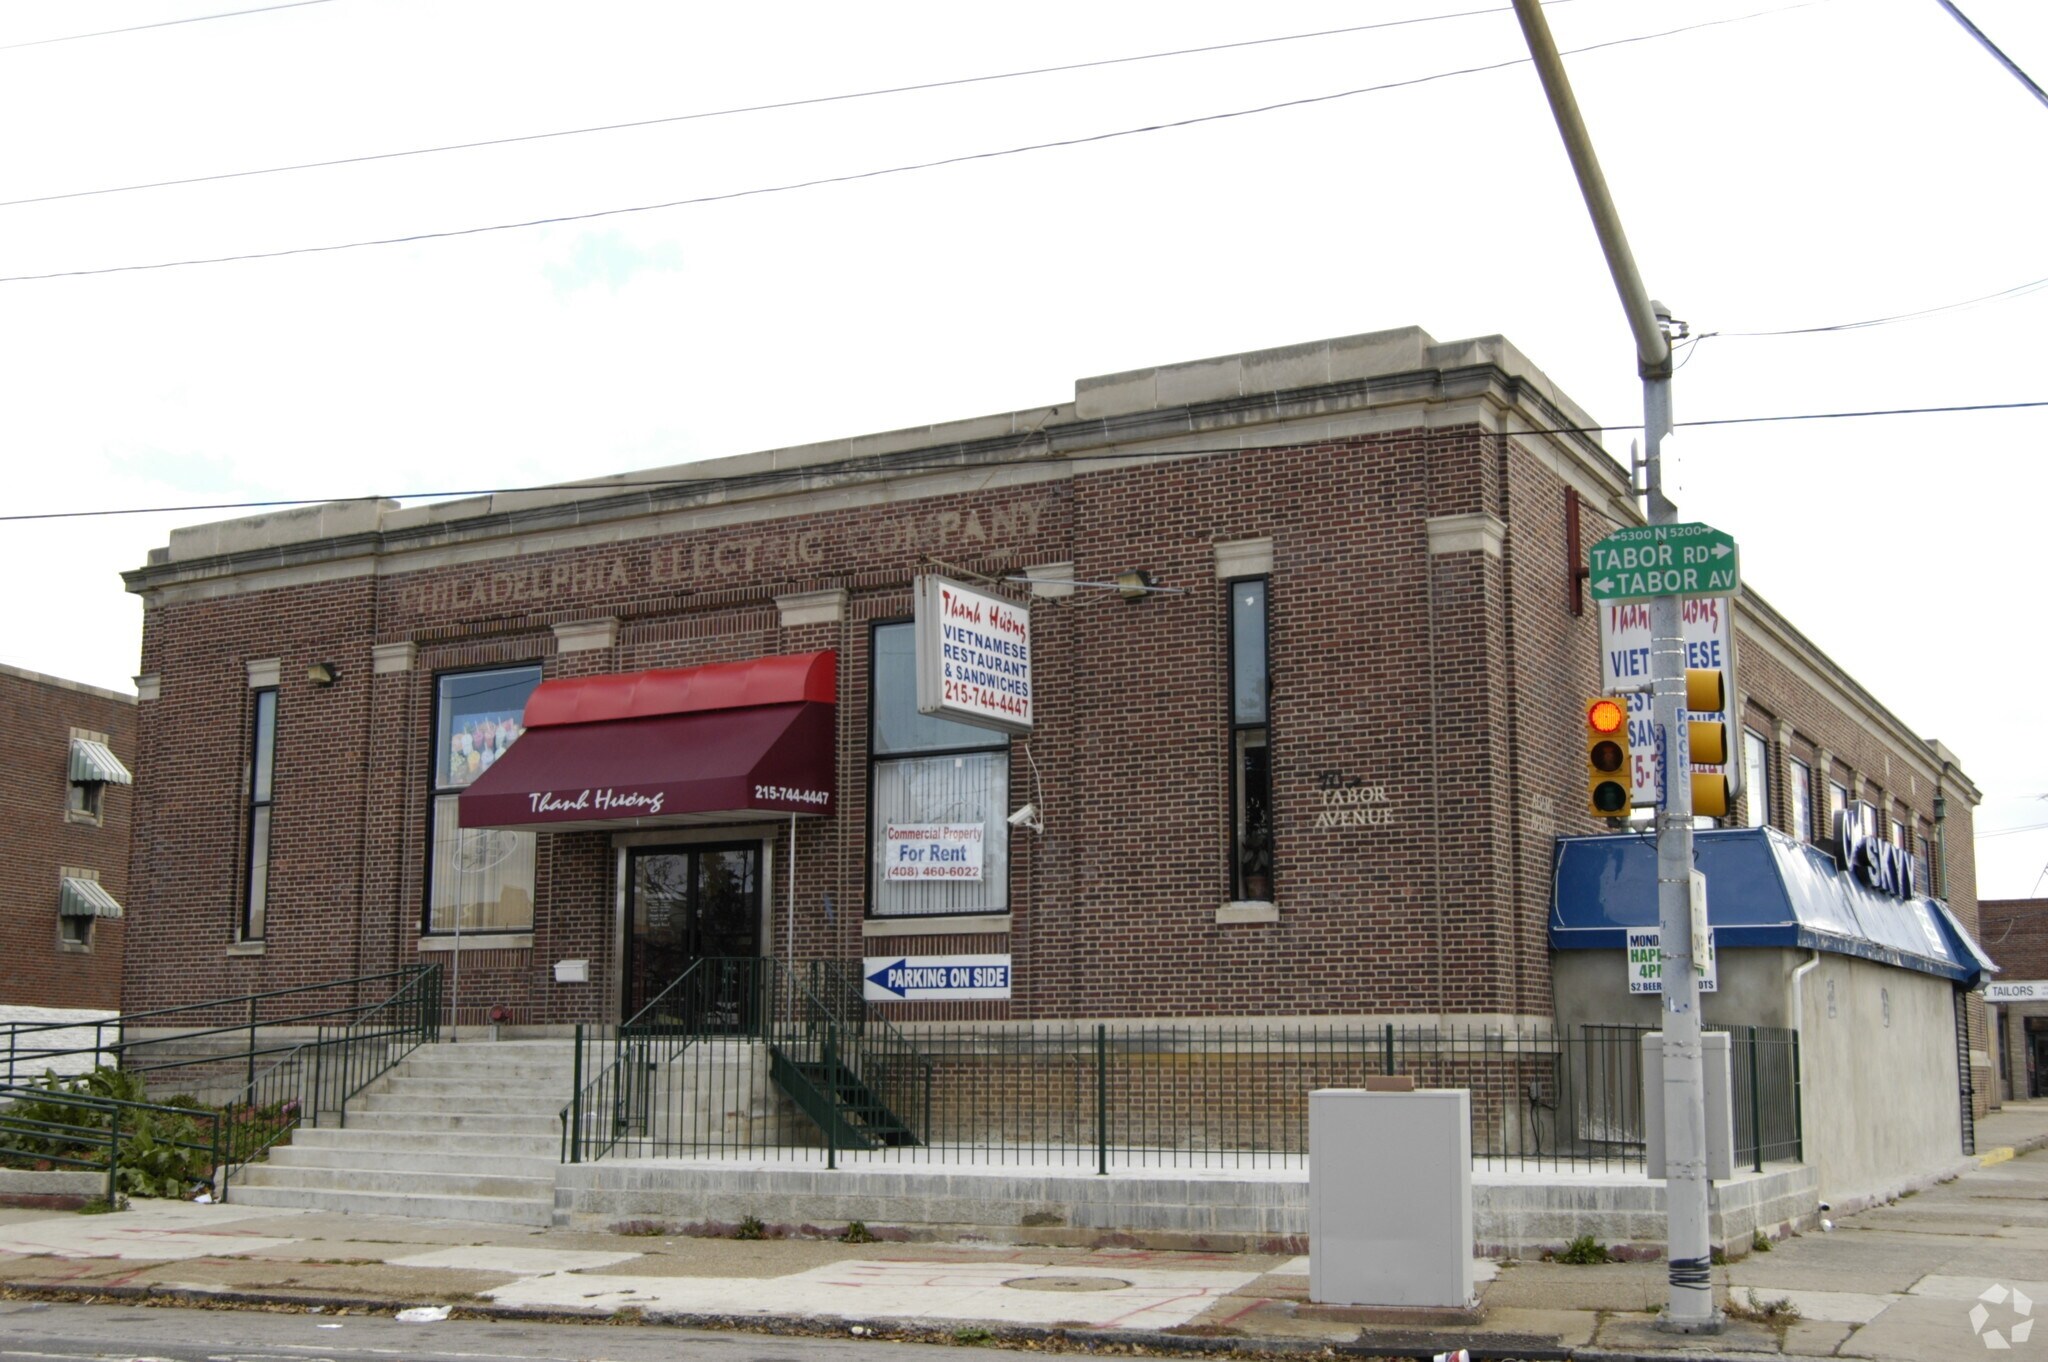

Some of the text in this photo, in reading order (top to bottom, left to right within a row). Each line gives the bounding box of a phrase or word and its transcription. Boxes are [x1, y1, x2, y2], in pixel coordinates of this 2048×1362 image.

[1620, 526, 1701, 541] 5300 N 5200
[1593, 545, 1709, 571] TABOR RD
[1616, 568, 1734, 594] TABOR AV
[942, 590, 981, 623] Thanh
[944, 624, 1027, 660] VIETNAMESE
[944, 643, 1028, 678] RESTAURANT
[945, 662, 1028, 697] & SANDWICHES
[945, 680, 1028, 717] 215-744-4447
[529, 789, 590, 813] Thanh
[755, 785, 829, 805] 215-744-4447
[1321, 786, 1390, 806] TABOR
[1314, 808, 1395, 828] AVENUE
[888, 827, 982, 842] Commercial Property
[900, 844, 967, 862] For Rent
[887, 866, 979, 879] (408) 460-6022
[1630, 934, 1660, 948] MOND
[888, 967, 1005, 988] PARKING ON SIDE
[1631, 983, 1641, 992] $2
[1992, 986, 2034, 996] TAILORS
